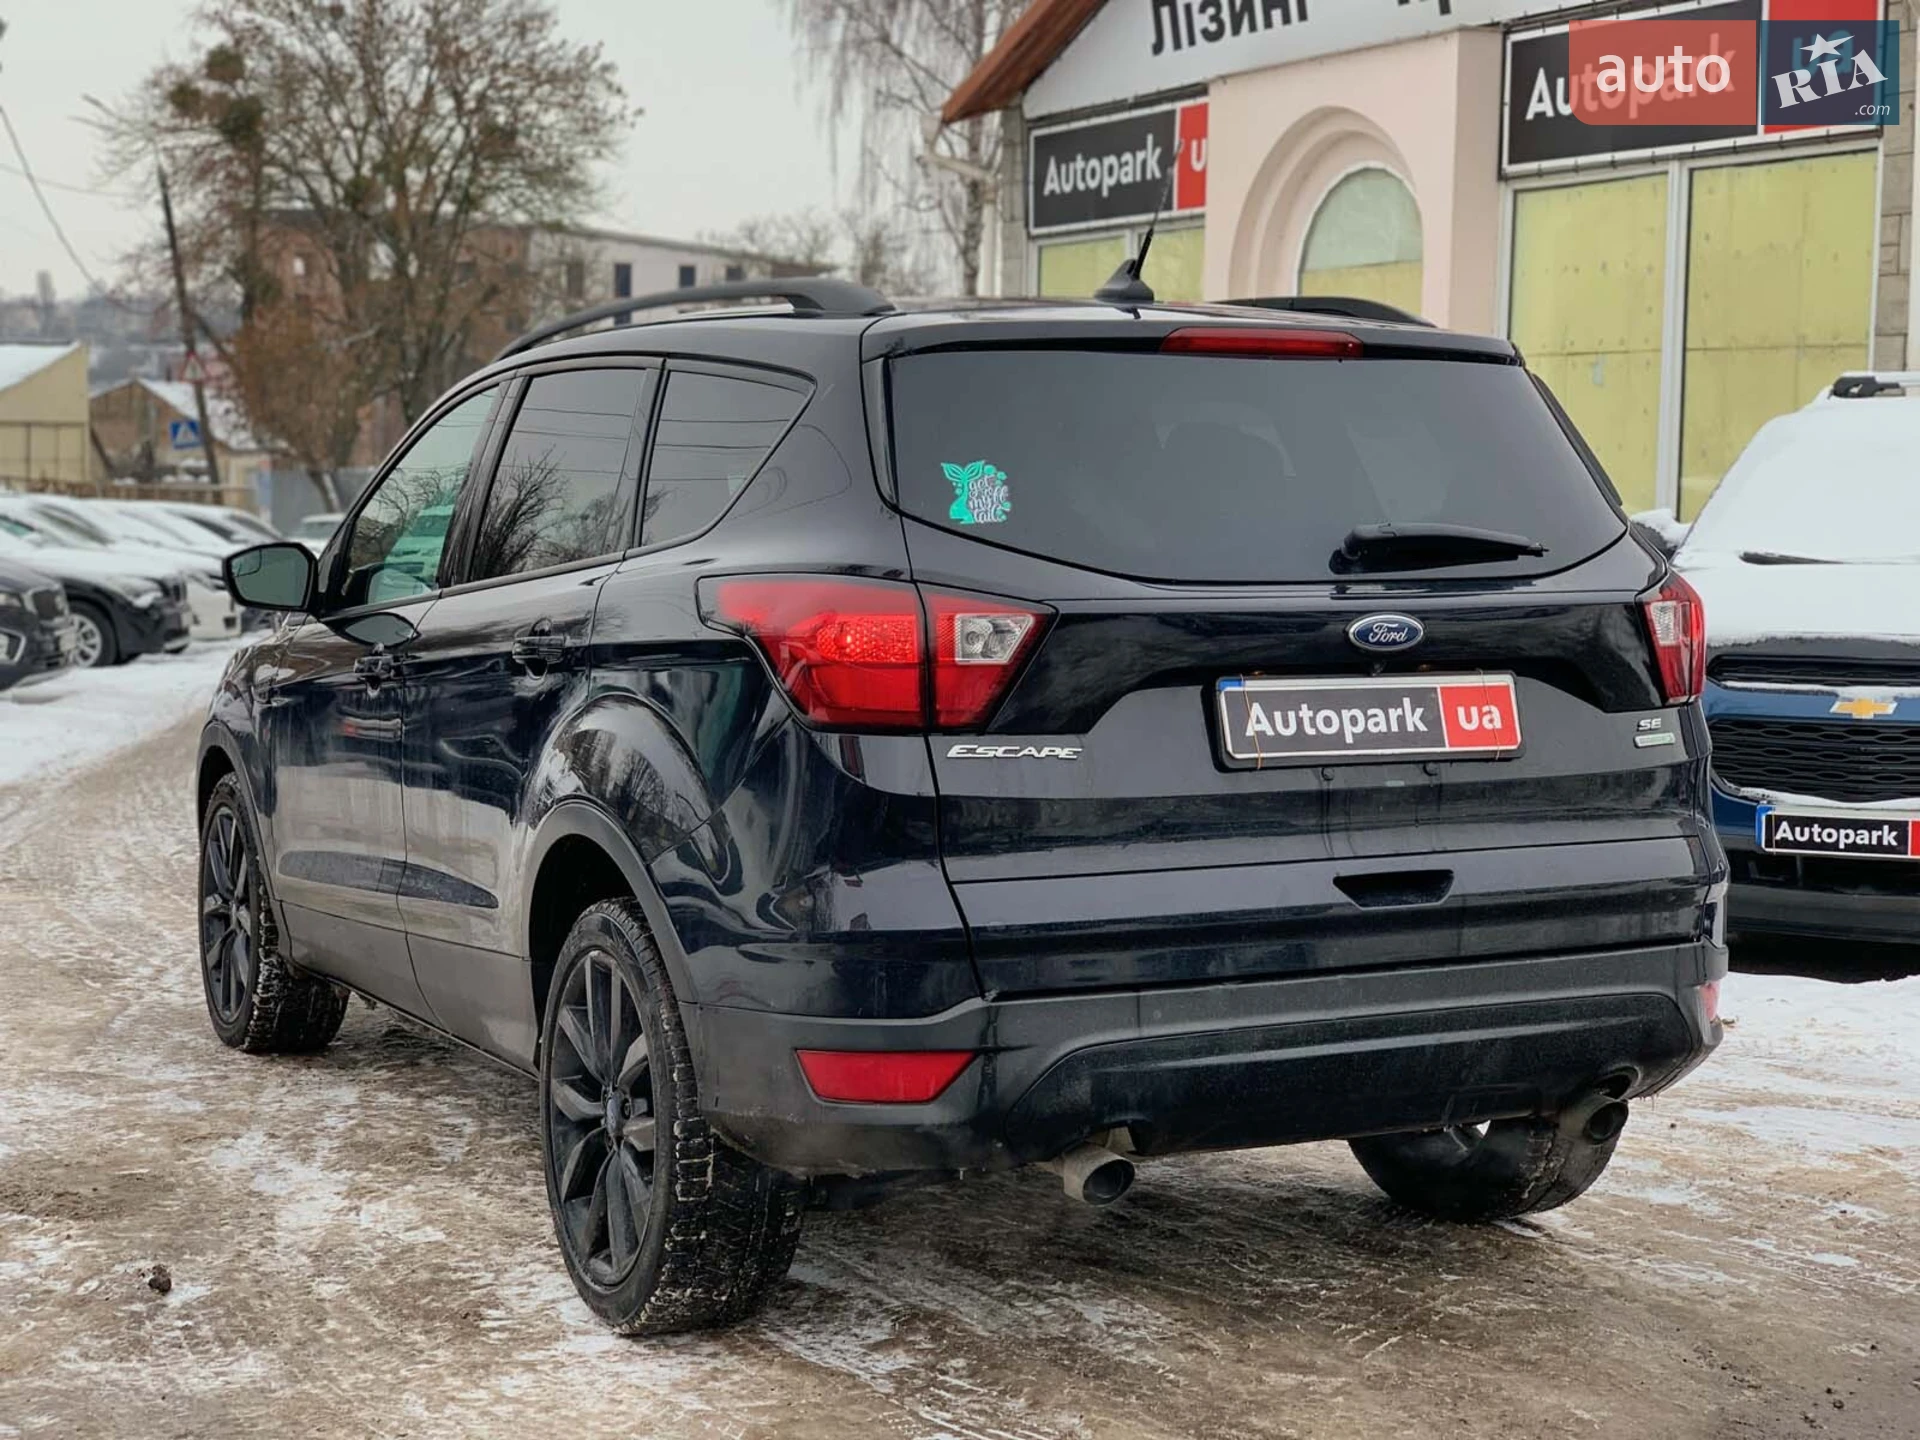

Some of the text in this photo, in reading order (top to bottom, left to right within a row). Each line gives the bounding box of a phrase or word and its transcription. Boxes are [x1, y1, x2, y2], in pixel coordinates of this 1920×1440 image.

[1043, 134, 1207, 198] Autopark u
[1368, 622, 1408, 643] Ford
[1245, 698, 1502, 744] Autopark ua
[1638, 718, 1662, 731] SE
[947, 744, 1082, 759] ESCAPE
[1775, 820, 1898, 849] Autopark
